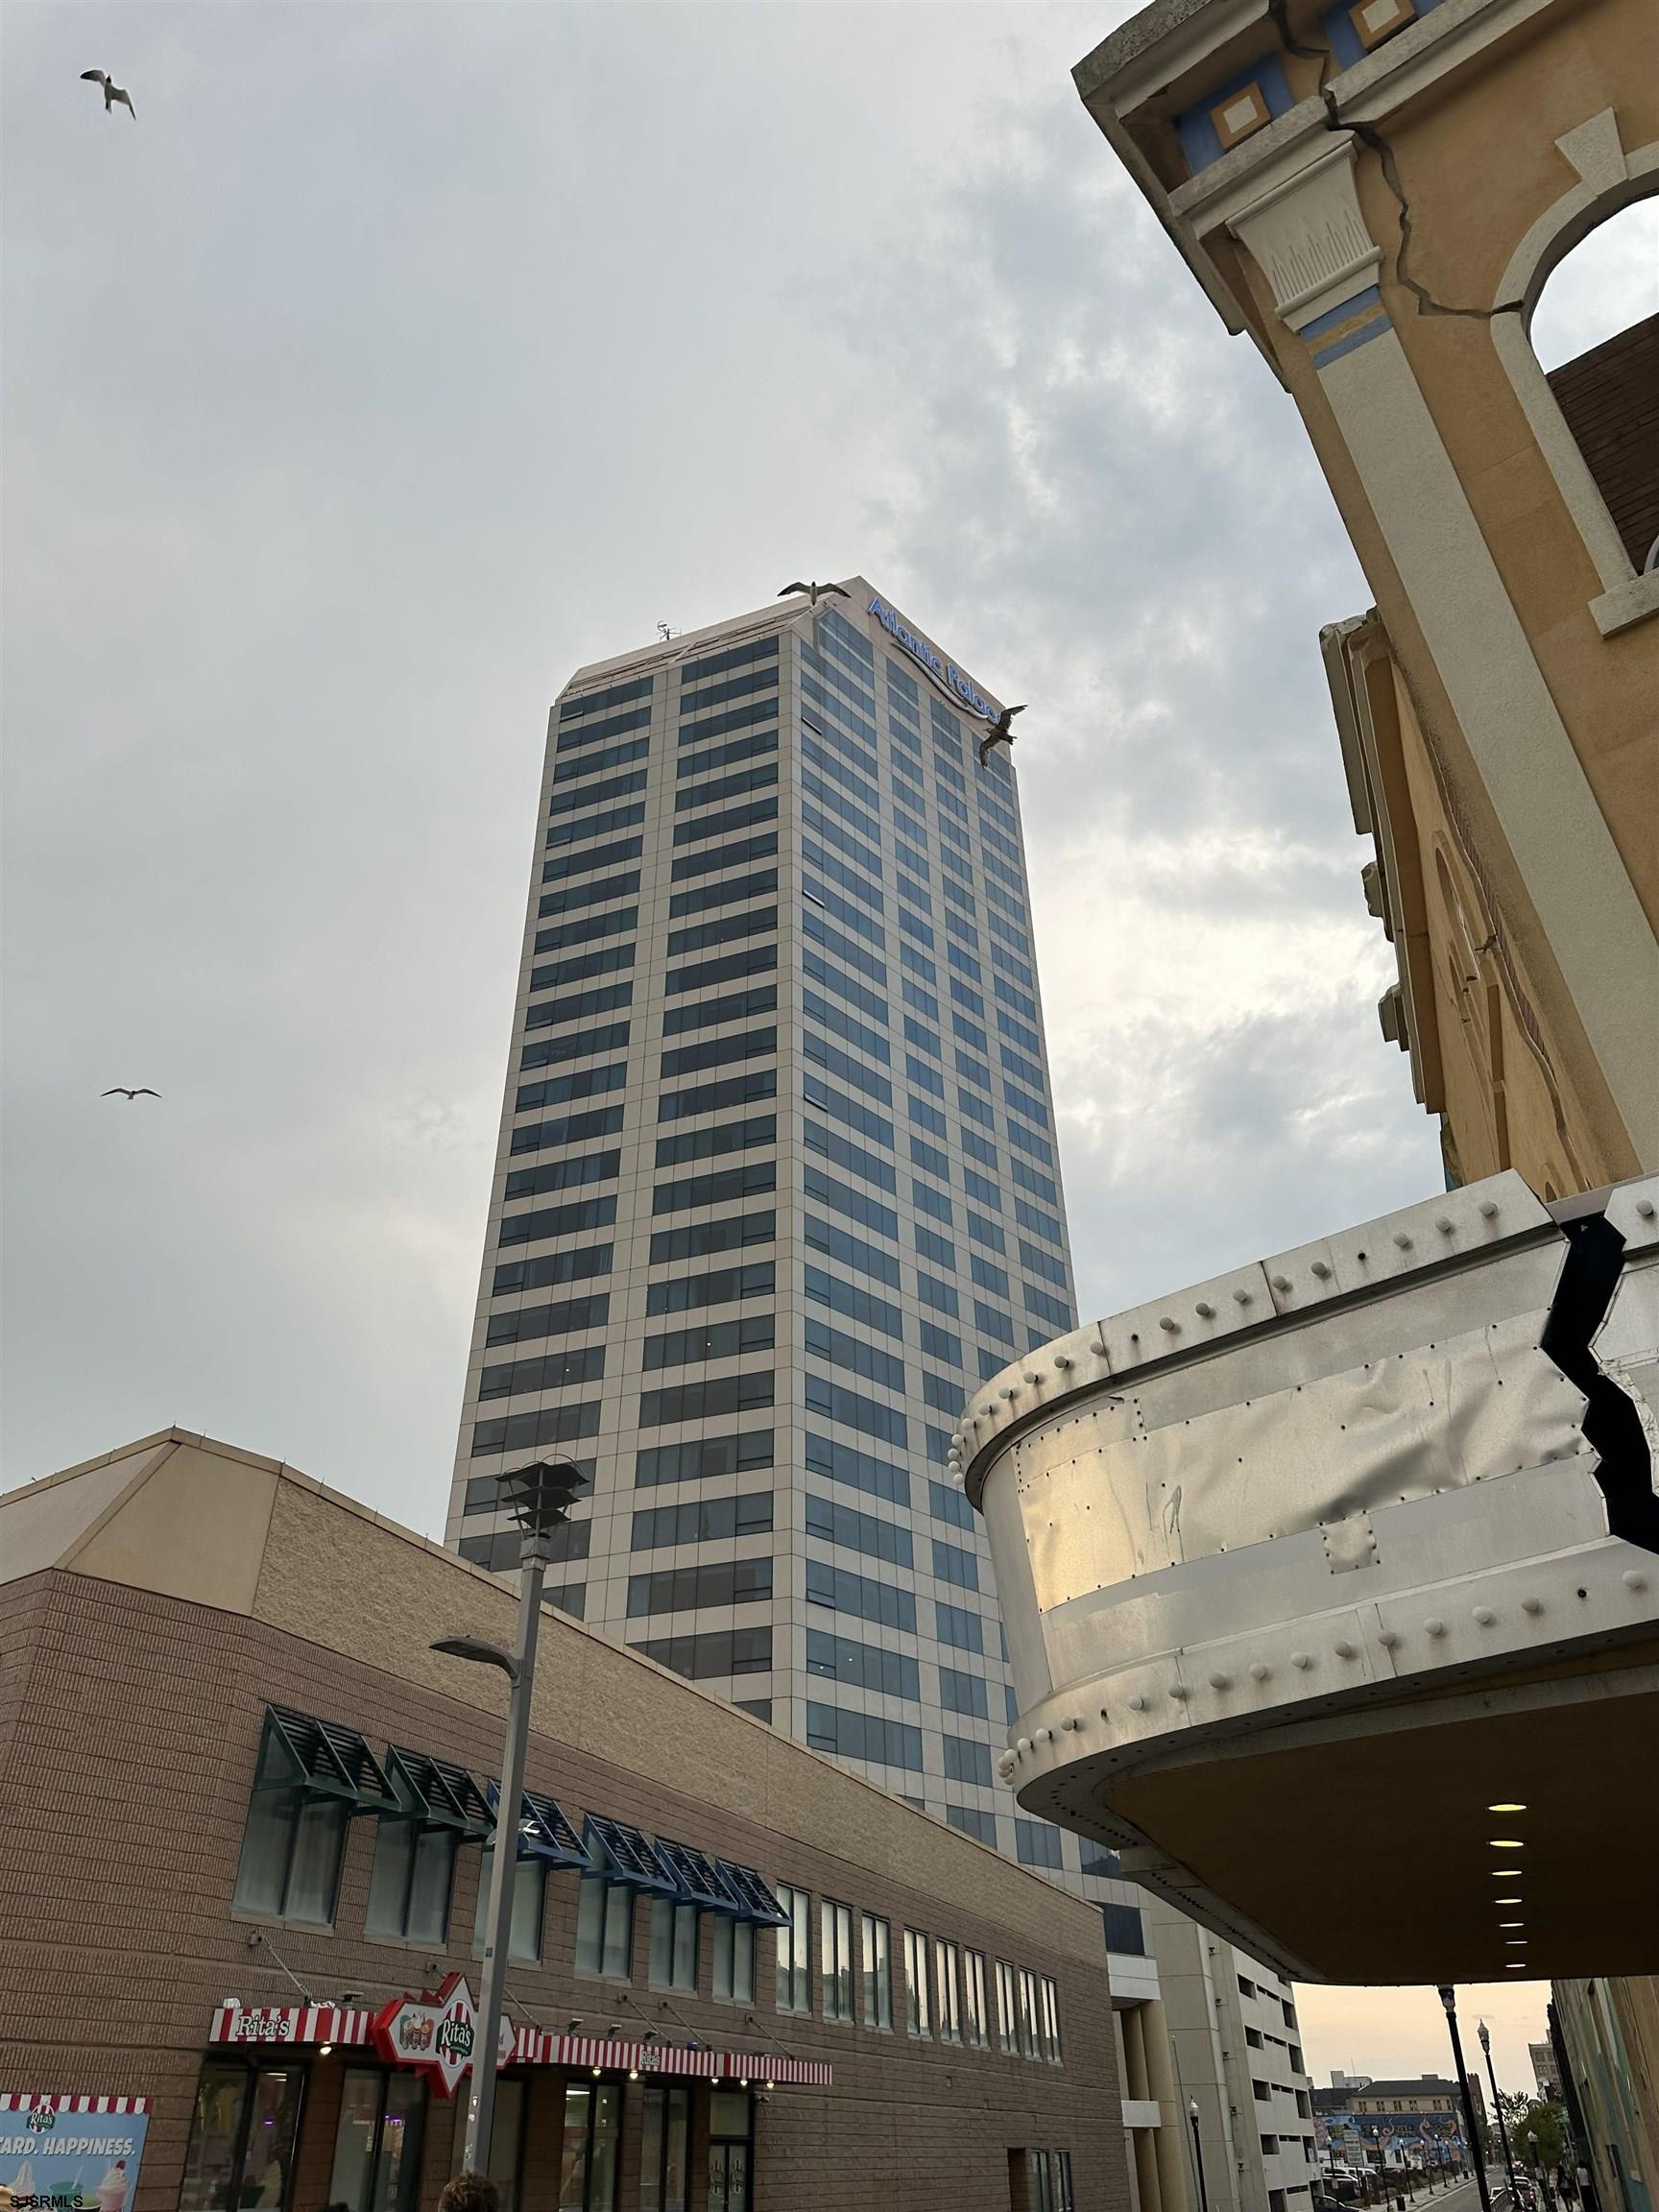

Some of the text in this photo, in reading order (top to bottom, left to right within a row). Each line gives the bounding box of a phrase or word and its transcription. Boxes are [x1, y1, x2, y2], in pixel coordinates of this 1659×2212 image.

[869, 597, 1001, 726] Atlantic Palac
[235, 2014, 291, 2038] Rita's
[441, 2018, 471, 2047] Rita's
[30, 2112, 54, 2126] Rita's
[42, 2137, 135, 2156] HAPPINESS.
